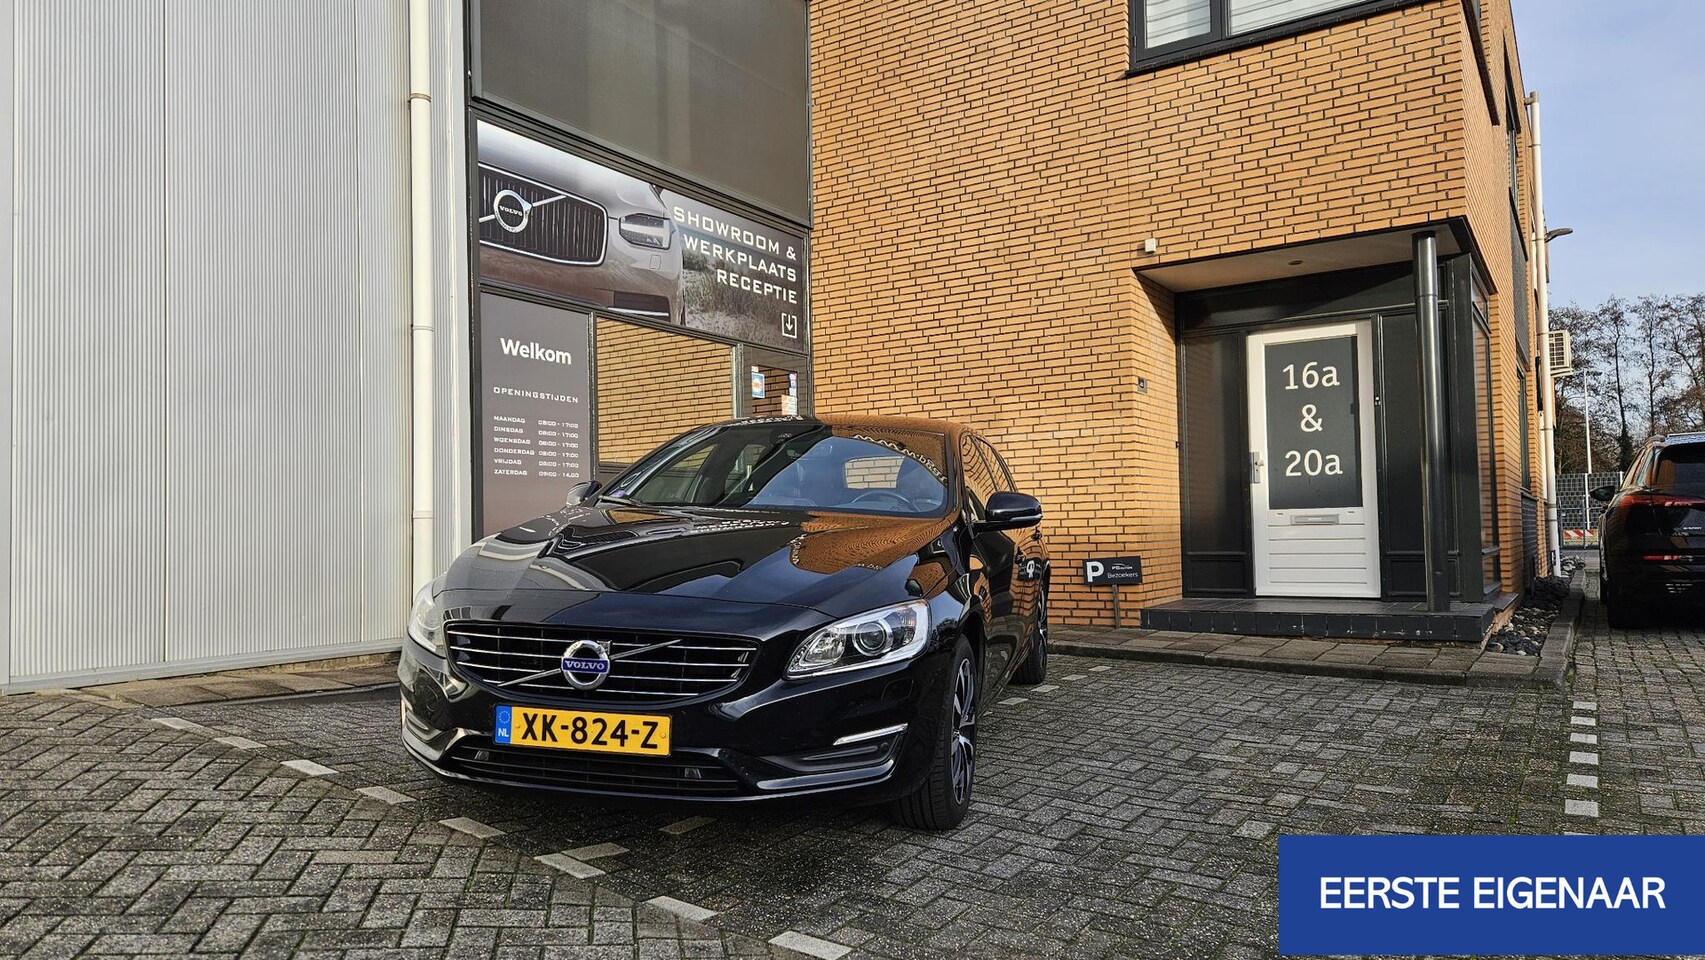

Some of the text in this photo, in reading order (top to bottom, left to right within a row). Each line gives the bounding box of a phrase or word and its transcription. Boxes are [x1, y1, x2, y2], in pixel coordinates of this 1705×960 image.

[499, 205, 523, 217] VOLVO
[673, 206, 797, 261] SHOWROOM &
[683, 233, 797, 282] WERKPLAATS
[717, 268, 797, 304] RECEPTIE
[500, 337, 572, 365] Welkom
[1282, 361, 1340, 390] 16a
[493, 386, 579, 403] OPENINGSTIJDEN
[493, 415, 526, 424] MAANDAG
[1300, 403, 1323, 432] &
[493, 426, 524, 434] DINSDAG
[493, 436, 531, 445] WOENSDAG
[493, 447, 535, 456] DONDERDAG
[1284, 449, 1343, 477] 20a
[1086, 561, 1104, 583] P
[564, 660, 606, 670] VOLVO
[497, 727, 510, 738] NL
[521, 712, 659, 749] XK-824-Z
